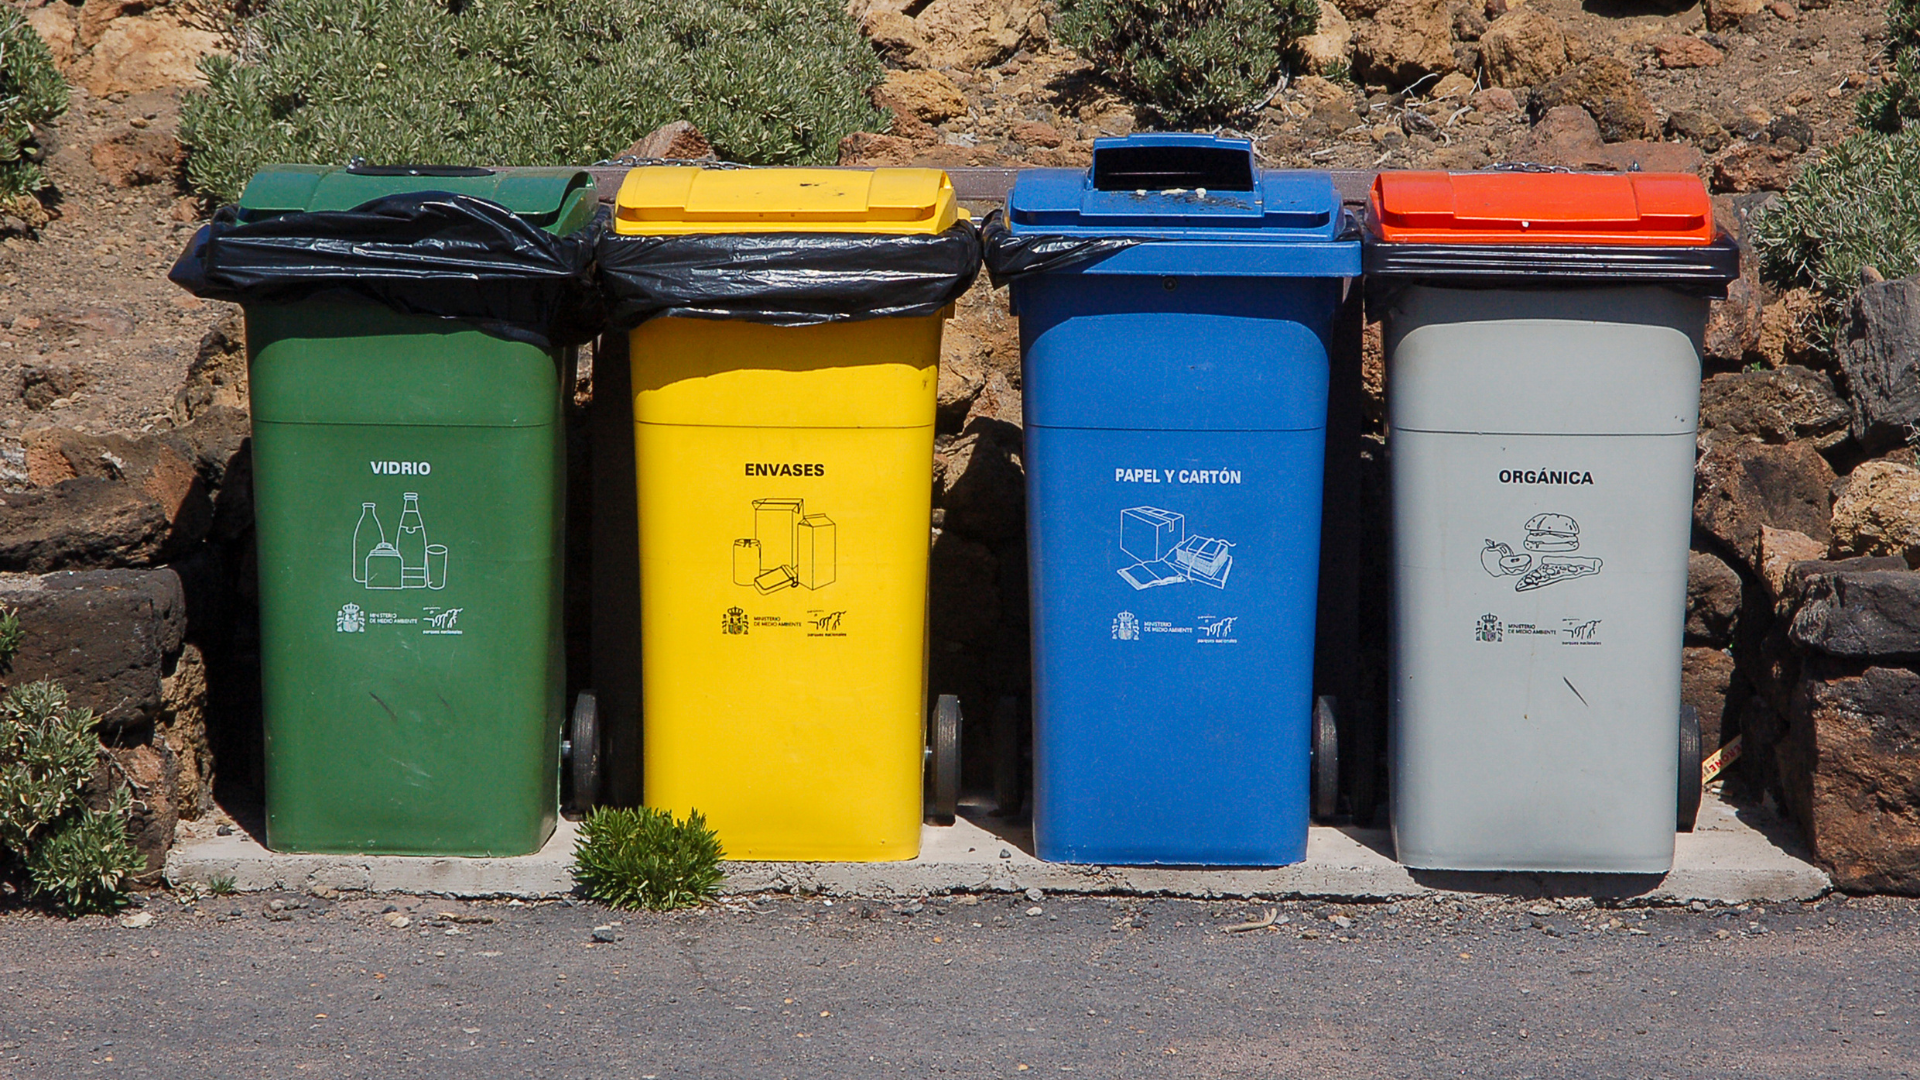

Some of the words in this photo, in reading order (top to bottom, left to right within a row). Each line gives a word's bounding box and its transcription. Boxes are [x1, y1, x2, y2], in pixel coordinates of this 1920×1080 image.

[370, 461, 431, 475] VIDRIO
[745, 463, 825, 477] ENVASES
[1115, 468, 1161, 483] PAPEL
[1164, 469, 1175, 484] Y
[1178, 467, 1241, 484] CARTÓN
[1498, 467, 1594, 485] ORGÁNICA
[1708, 743, 1742, 773] ERONE
